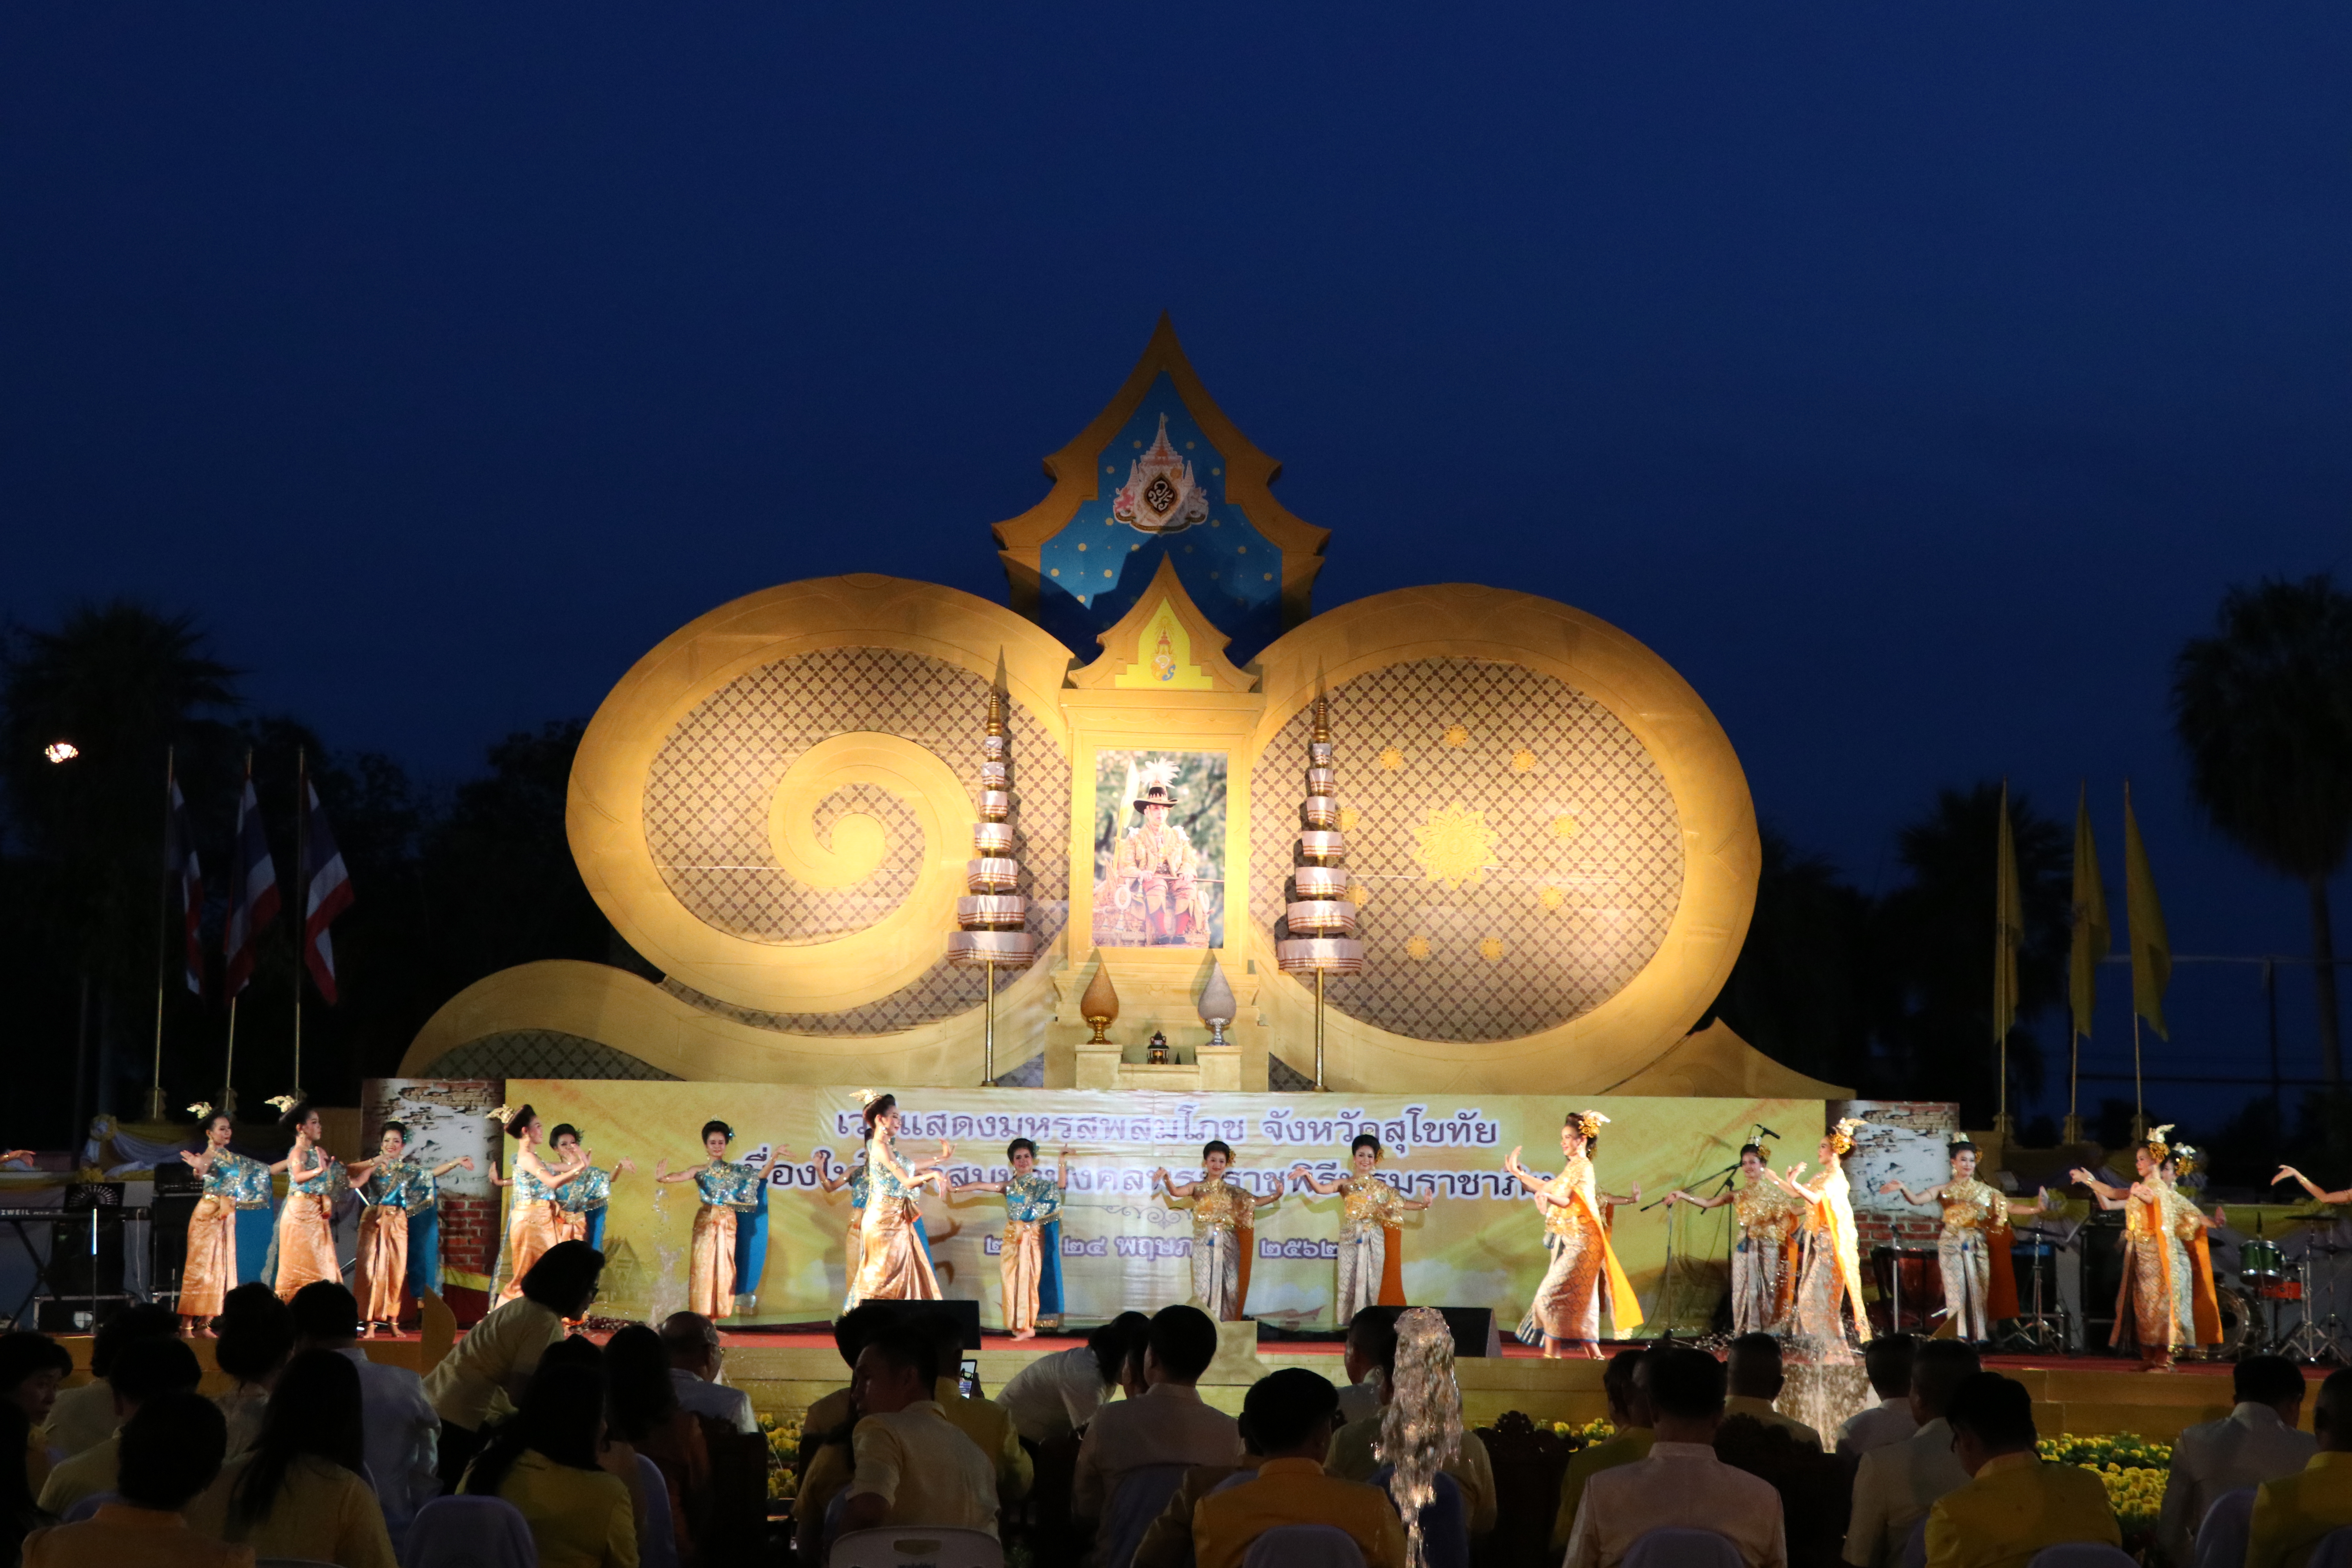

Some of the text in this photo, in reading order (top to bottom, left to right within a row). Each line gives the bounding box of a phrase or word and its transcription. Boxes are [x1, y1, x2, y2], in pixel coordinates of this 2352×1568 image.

[838, 1105, 1497, 1154] เวแสดงมหรสพสมโภช จังหวัดสุโขทัย
[1114, 1236, 1195, 1262] พฤษภ
[1259, 1237, 1339, 1259] ๒๕๖๒
